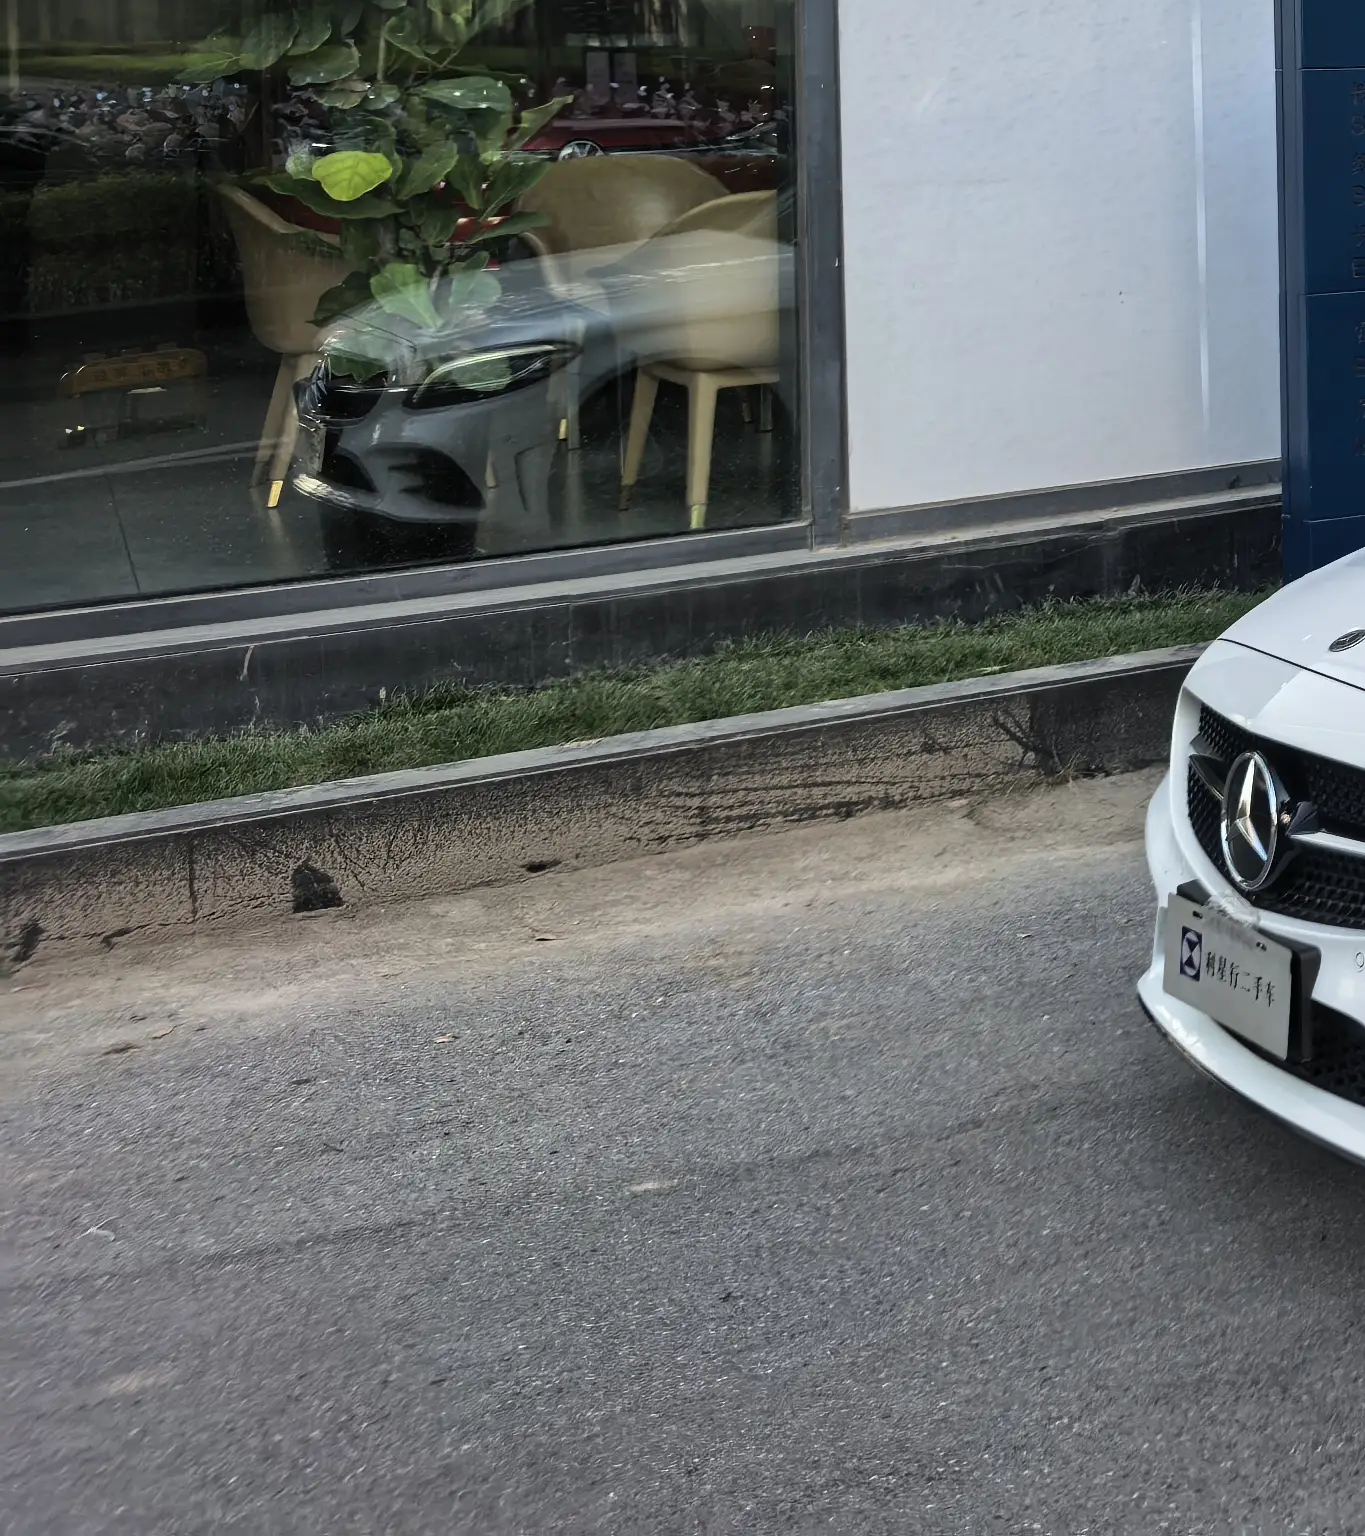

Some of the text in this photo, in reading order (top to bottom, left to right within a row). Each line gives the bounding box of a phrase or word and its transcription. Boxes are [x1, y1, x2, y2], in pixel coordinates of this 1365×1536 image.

[1206, 951, 1276, 1008] 利星行二手车
